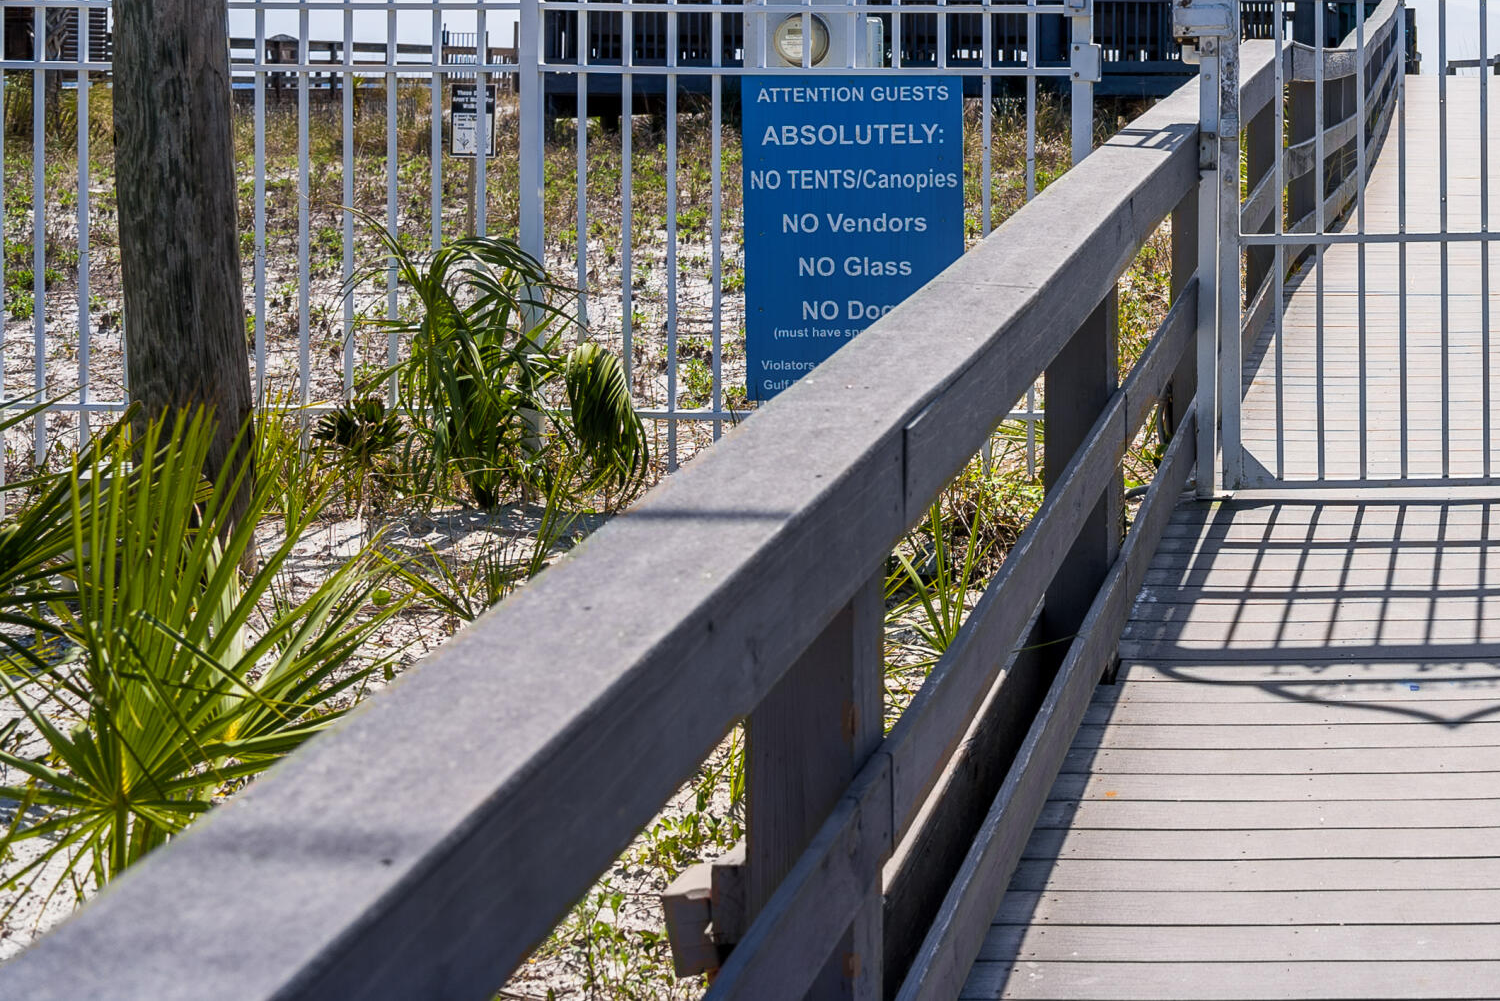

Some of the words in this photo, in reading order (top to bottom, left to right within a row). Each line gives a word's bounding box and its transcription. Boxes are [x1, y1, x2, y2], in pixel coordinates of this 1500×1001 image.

[757, 86, 864, 104] ATTENTION
[870, 85, 949, 102] GUESTS
[761, 123, 945, 146] ABSOLUTELY:
[751, 170, 781, 190] NO
[787, 168, 958, 193] TENTS/Canopies
[782, 213, 819, 234] NO
[827, 212, 927, 233] Vendors
[799, 257, 836, 277] NO
[843, 256, 912, 277] Glass
[802, 300, 839, 320] NO
[773, 327, 809, 340] (must
[812, 327, 841, 338] have
[761, 360, 815, 370] Violators
[763, 379, 789, 390] Gulf
